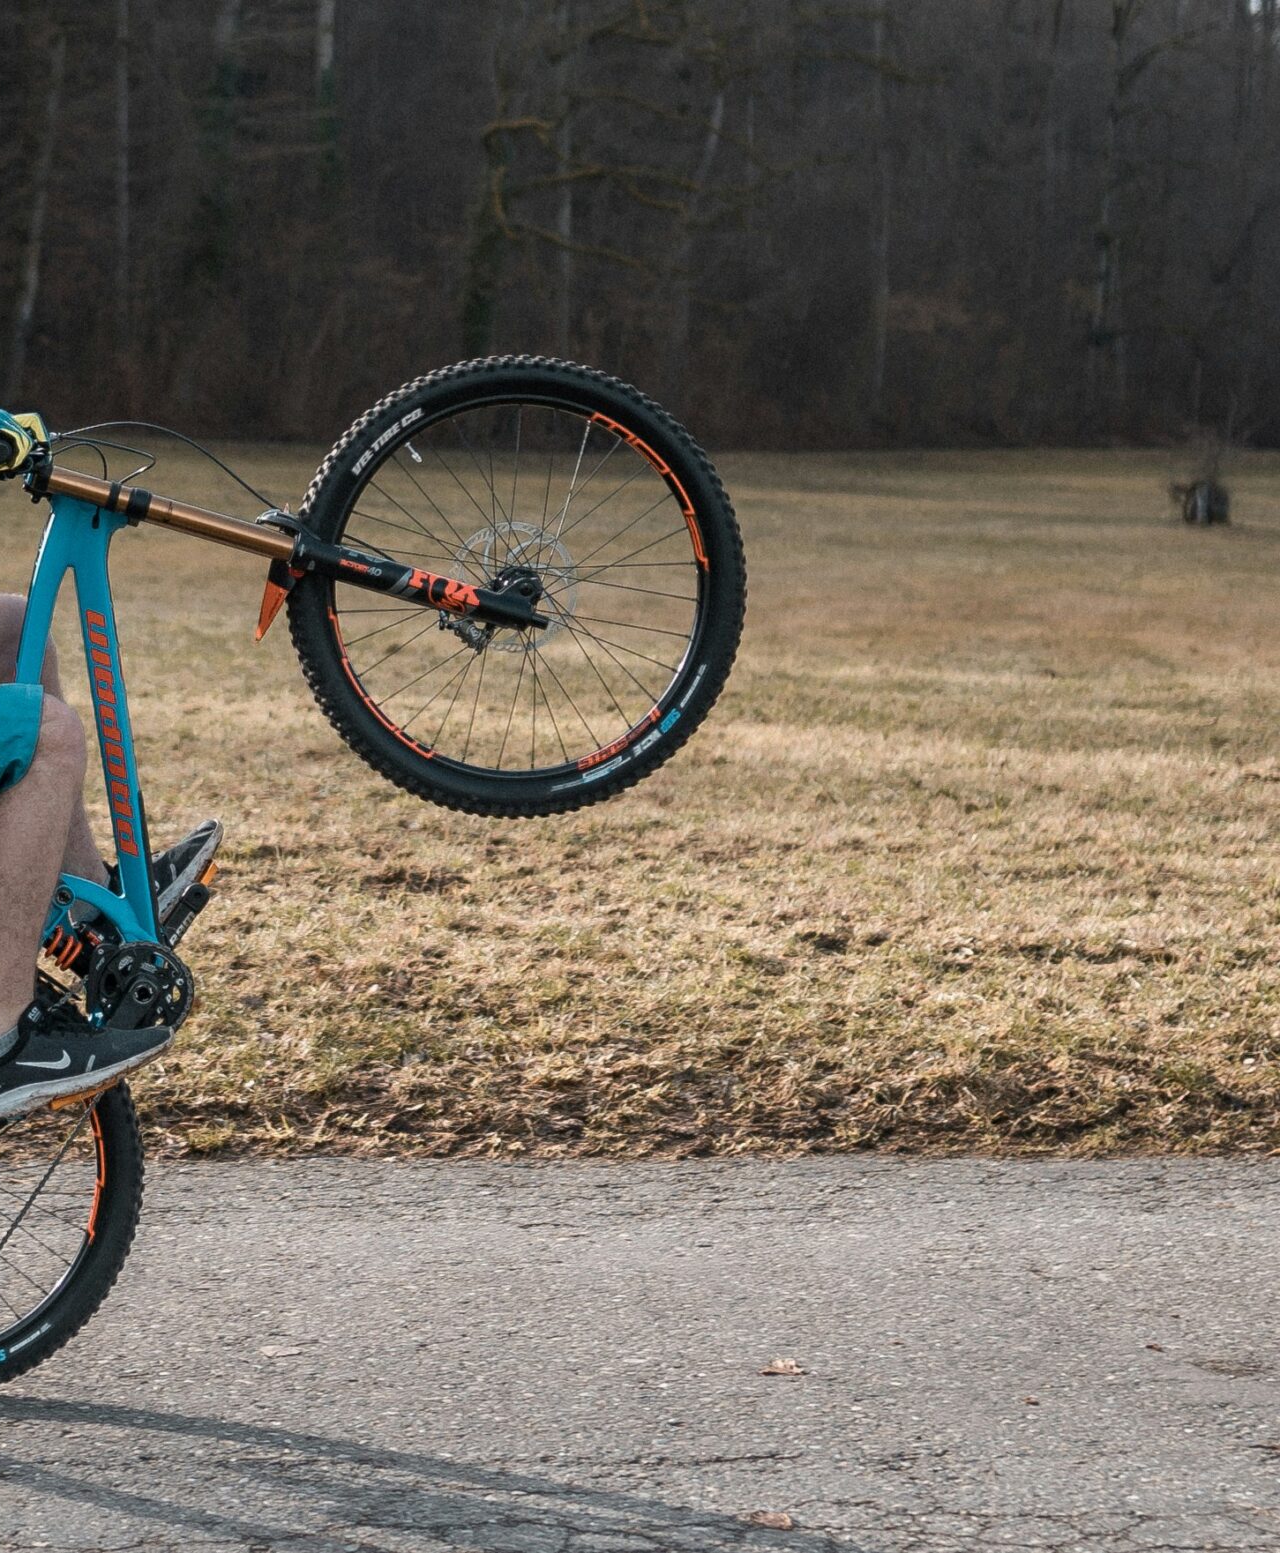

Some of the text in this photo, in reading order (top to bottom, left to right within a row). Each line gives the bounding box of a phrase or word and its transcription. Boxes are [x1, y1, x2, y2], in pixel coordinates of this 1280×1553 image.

[351, 448, 375, 477] VEE
[370, 421, 402, 452] TIRE
[367, 566, 383, 578] 40
[408, 567, 481, 614] FOX
